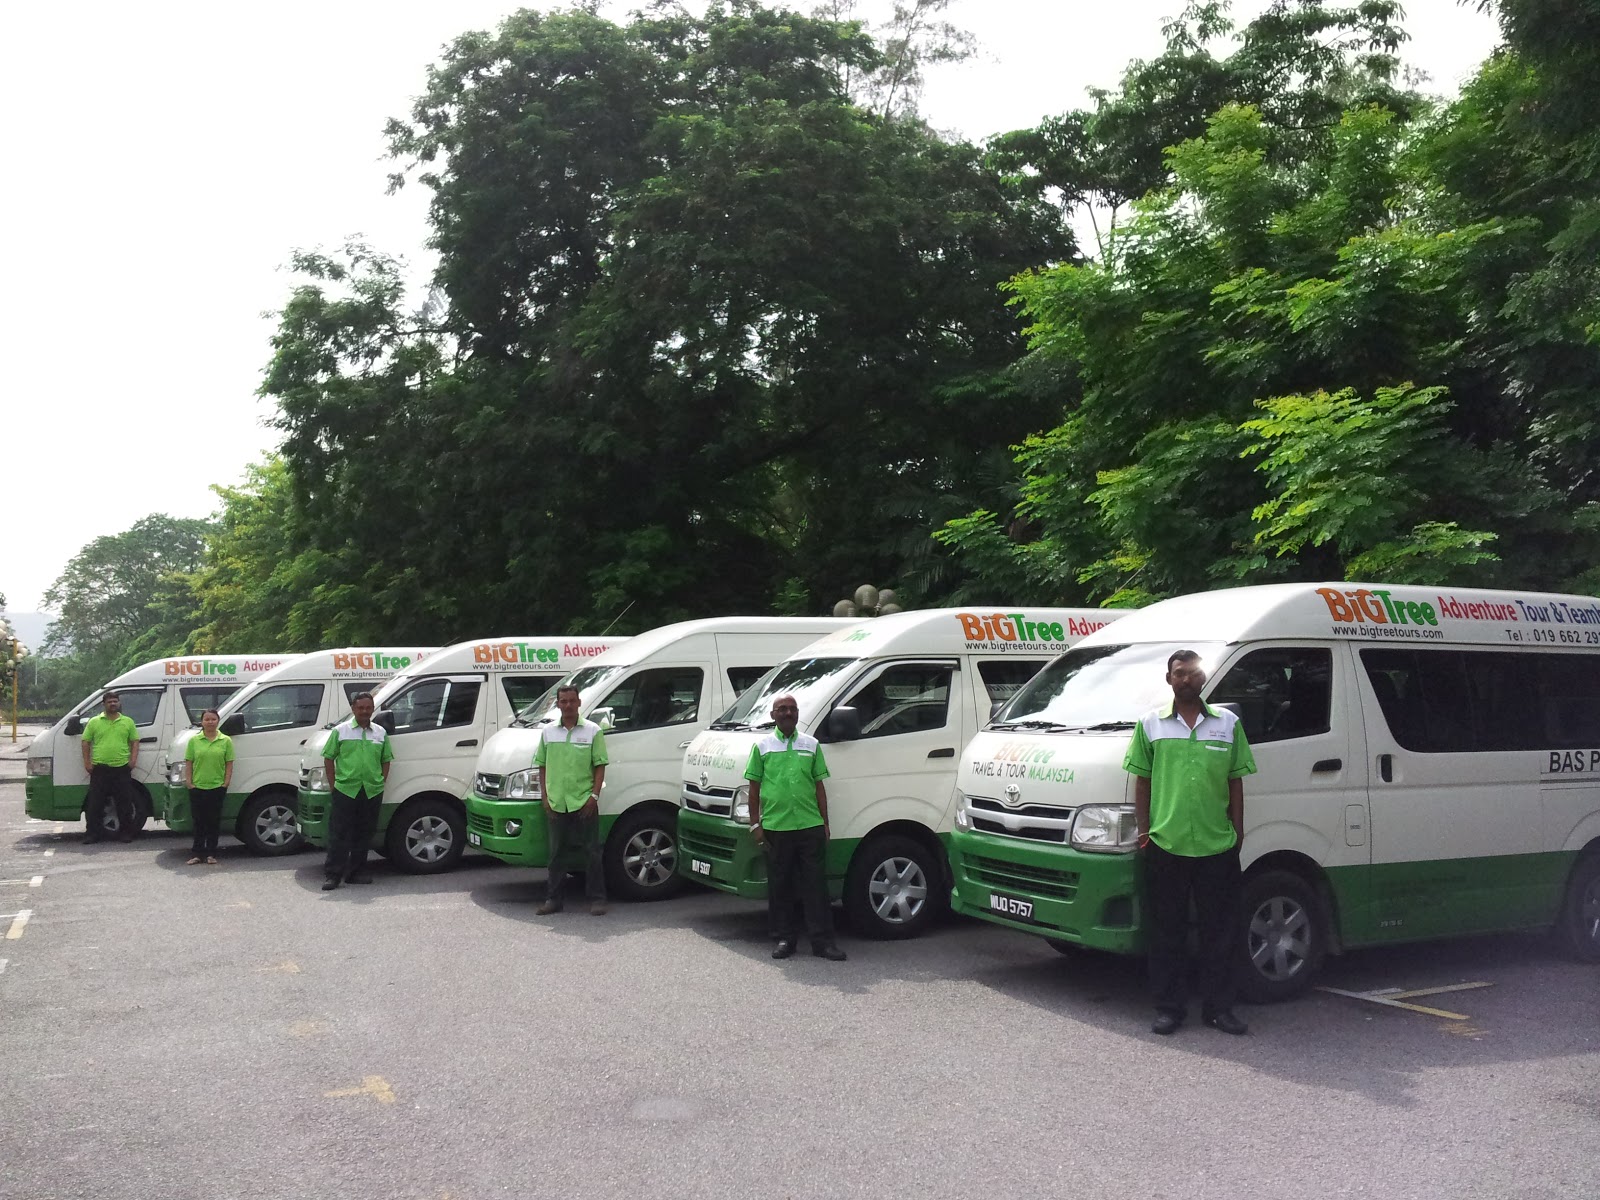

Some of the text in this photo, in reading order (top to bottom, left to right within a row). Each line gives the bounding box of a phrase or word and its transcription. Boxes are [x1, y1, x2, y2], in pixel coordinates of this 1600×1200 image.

[1437, 596, 1518, 621] Adventure
[1515, 600, 1551, 622] Tour
[1549, 602, 1565, 623] &
[1332, 625, 1444, 639] www.bigtreetours.com
[1505, 629, 1523, 641] Tel
[1533, 629, 1555, 642] 019
[1560, 630, 1581, 643] 662
[965, 641, 1070, 653] www.bigtreetours.com
[473, 663, 561, 671] www.bigtreetours.com
[1549, 751, 1585, 773] BAS
[972, 761, 1075, 784] TRAVEL & TOUR MALAYSIA
[1009, 899, 1033, 918] 5757
